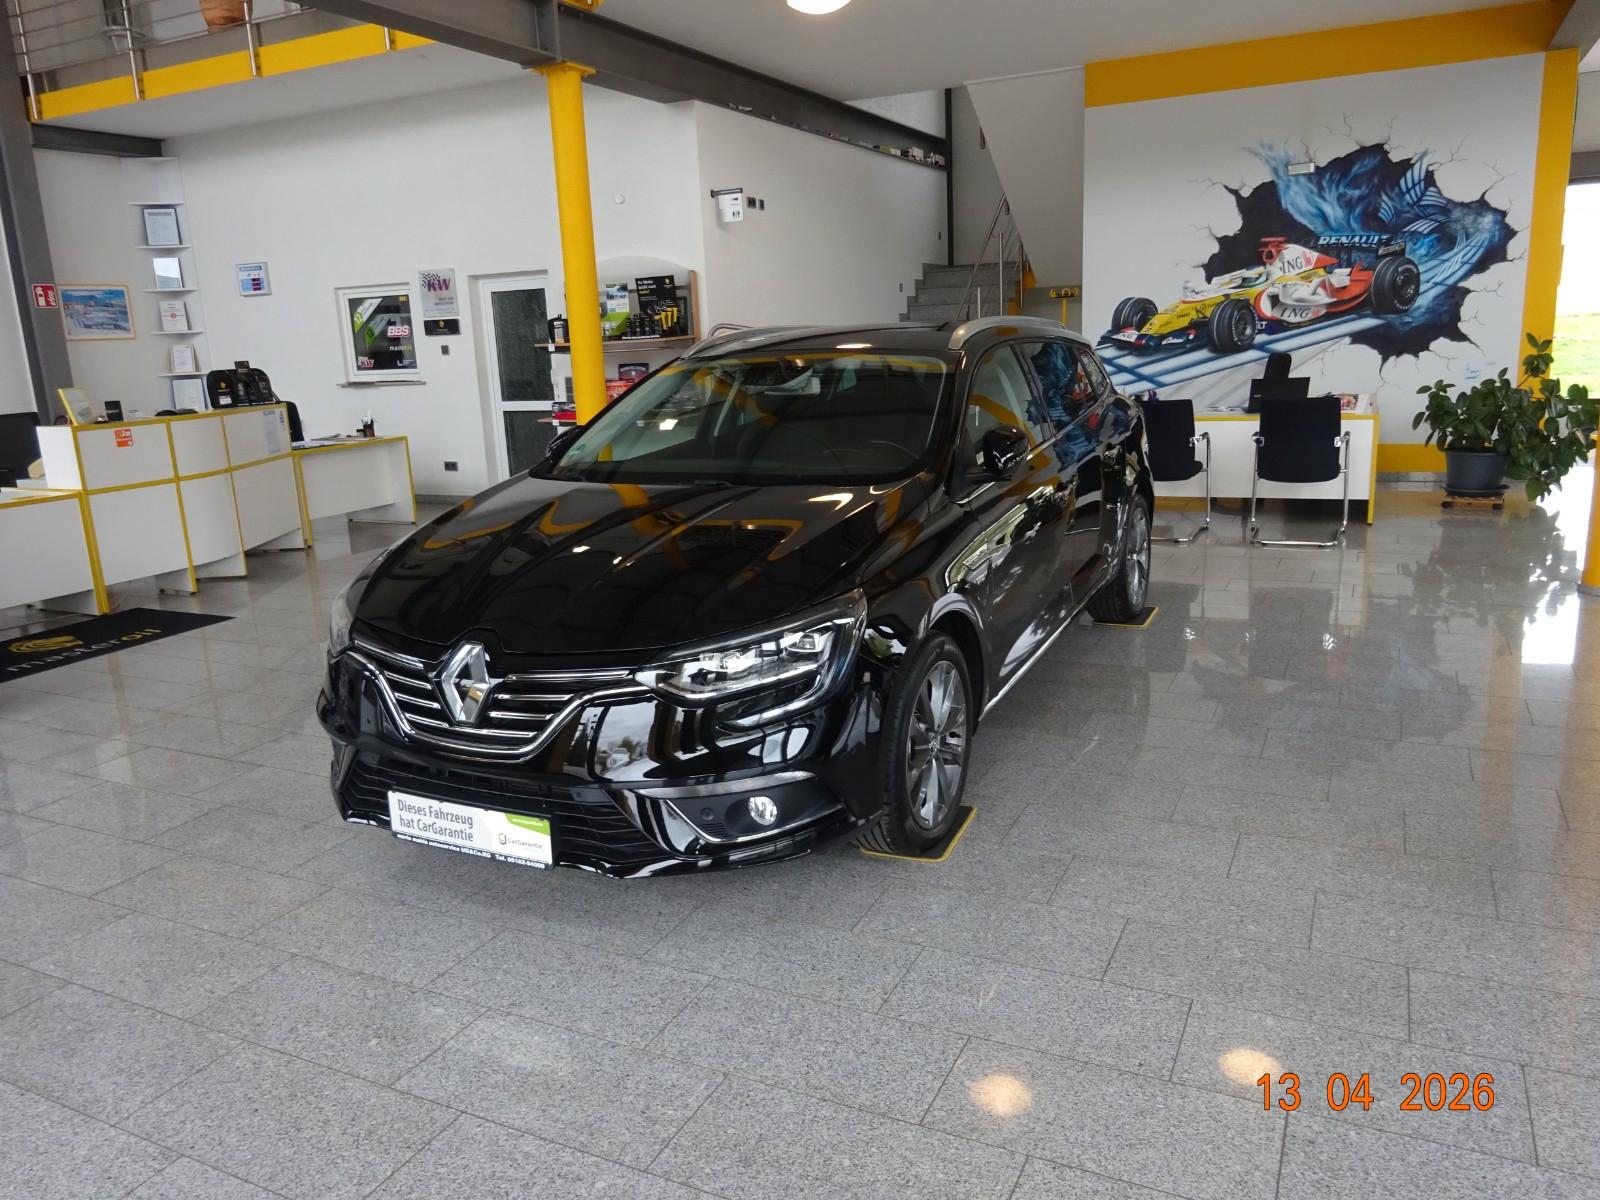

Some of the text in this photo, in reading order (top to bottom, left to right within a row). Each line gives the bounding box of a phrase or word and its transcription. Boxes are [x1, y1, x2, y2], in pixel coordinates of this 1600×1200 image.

[1280, 254, 1304, 275] ING
[427, 278, 451, 292] KW
[1279, 306, 1312, 320] ING
[387, 325, 411, 338] BBS
[6, 628, 163, 673] masteroil
[397, 798, 474, 829] Dieses Fahrzeug
[399, 814, 415, 830] hat
[416, 818, 474, 842] CarGarantie
[495, 854, 507, 862] Tel.
